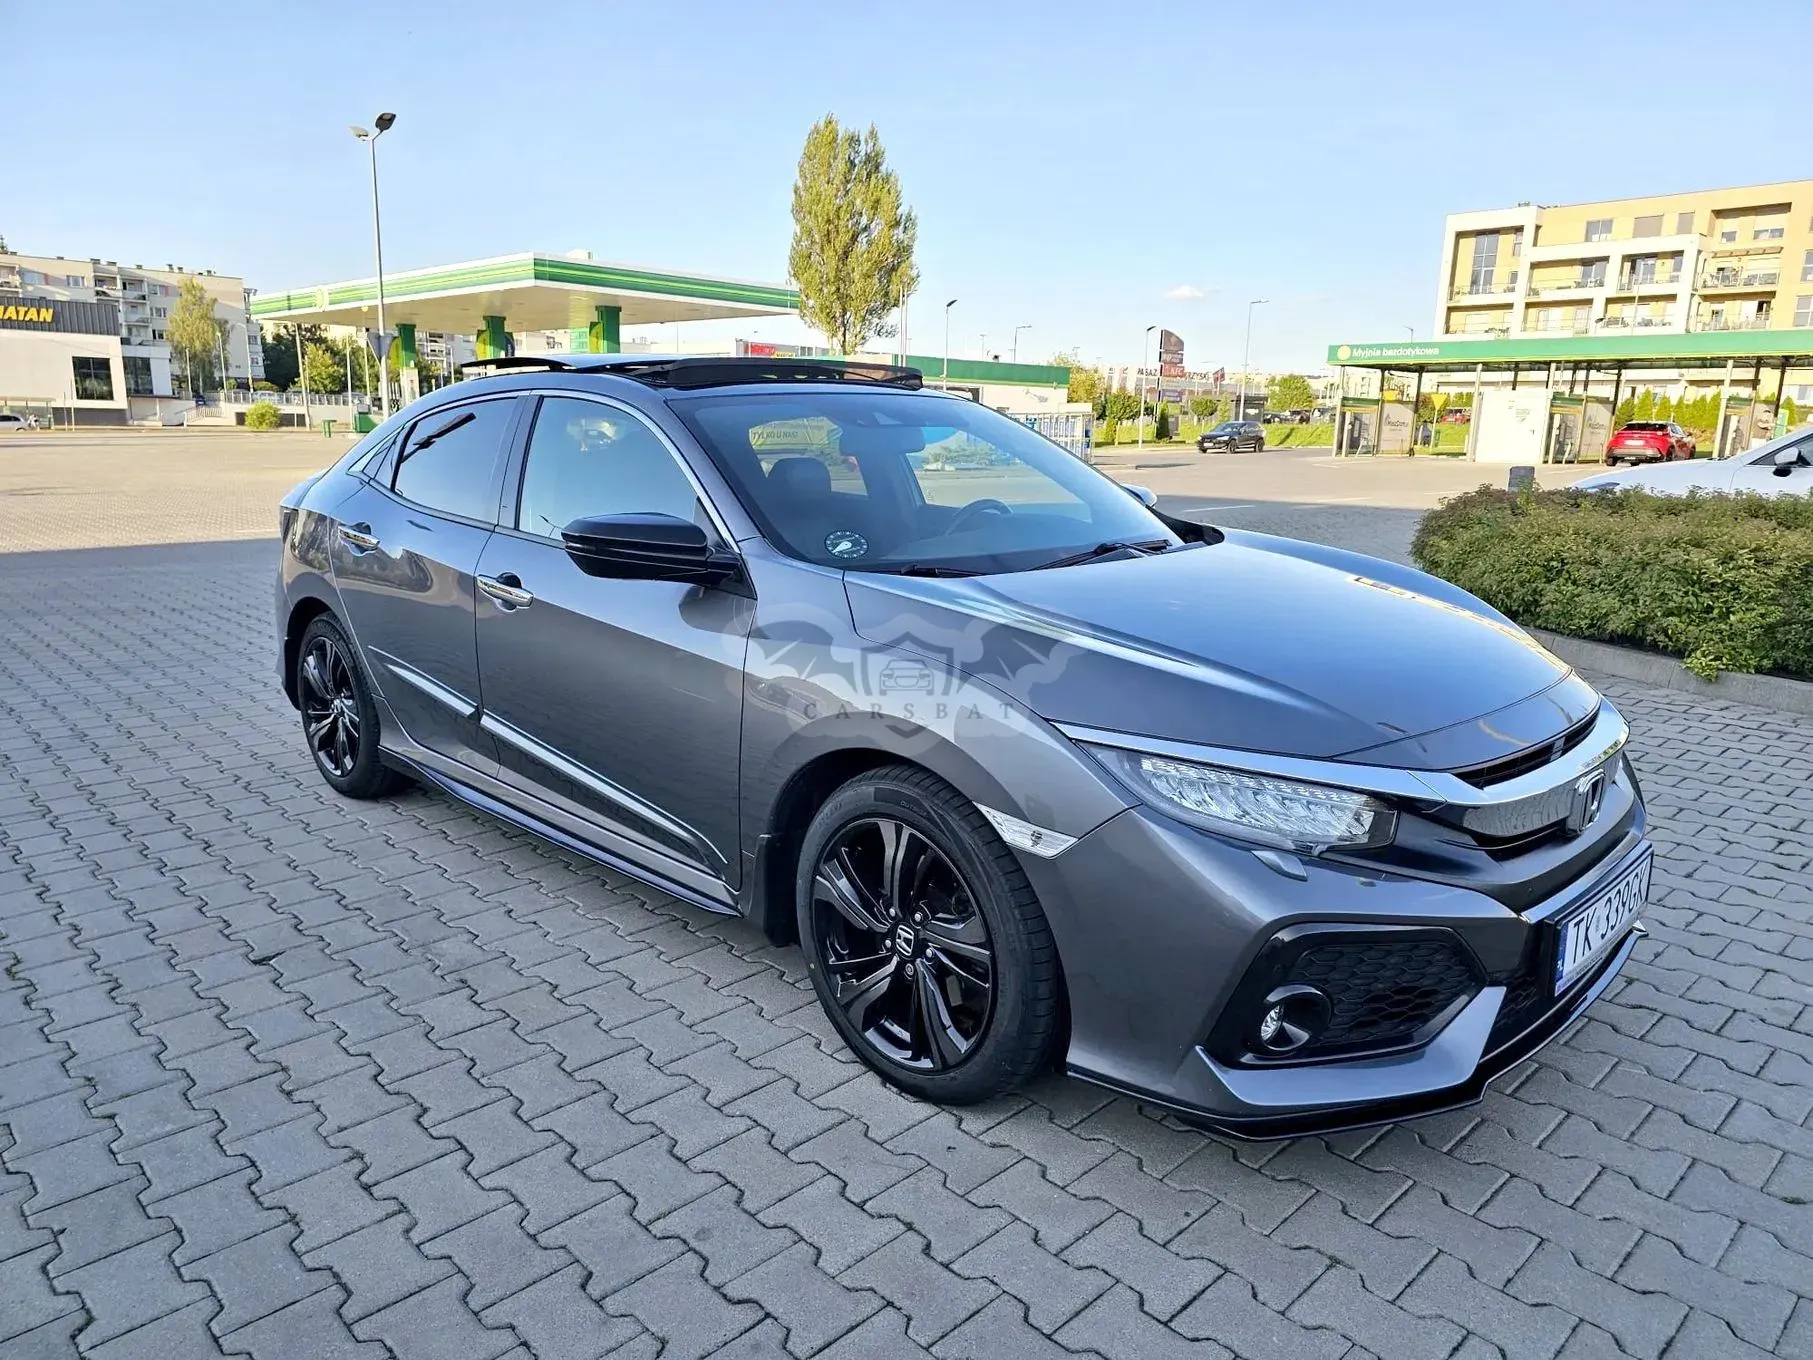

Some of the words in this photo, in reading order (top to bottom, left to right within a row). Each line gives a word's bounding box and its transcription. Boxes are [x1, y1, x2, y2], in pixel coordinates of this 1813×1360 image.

[1352, 347, 1381, 359] Myjnia
[1382, 346, 1440, 357] bezdotykowa
[1573, 906, 1598, 965] TK
[1600, 860, 1649, 941] 339GK
